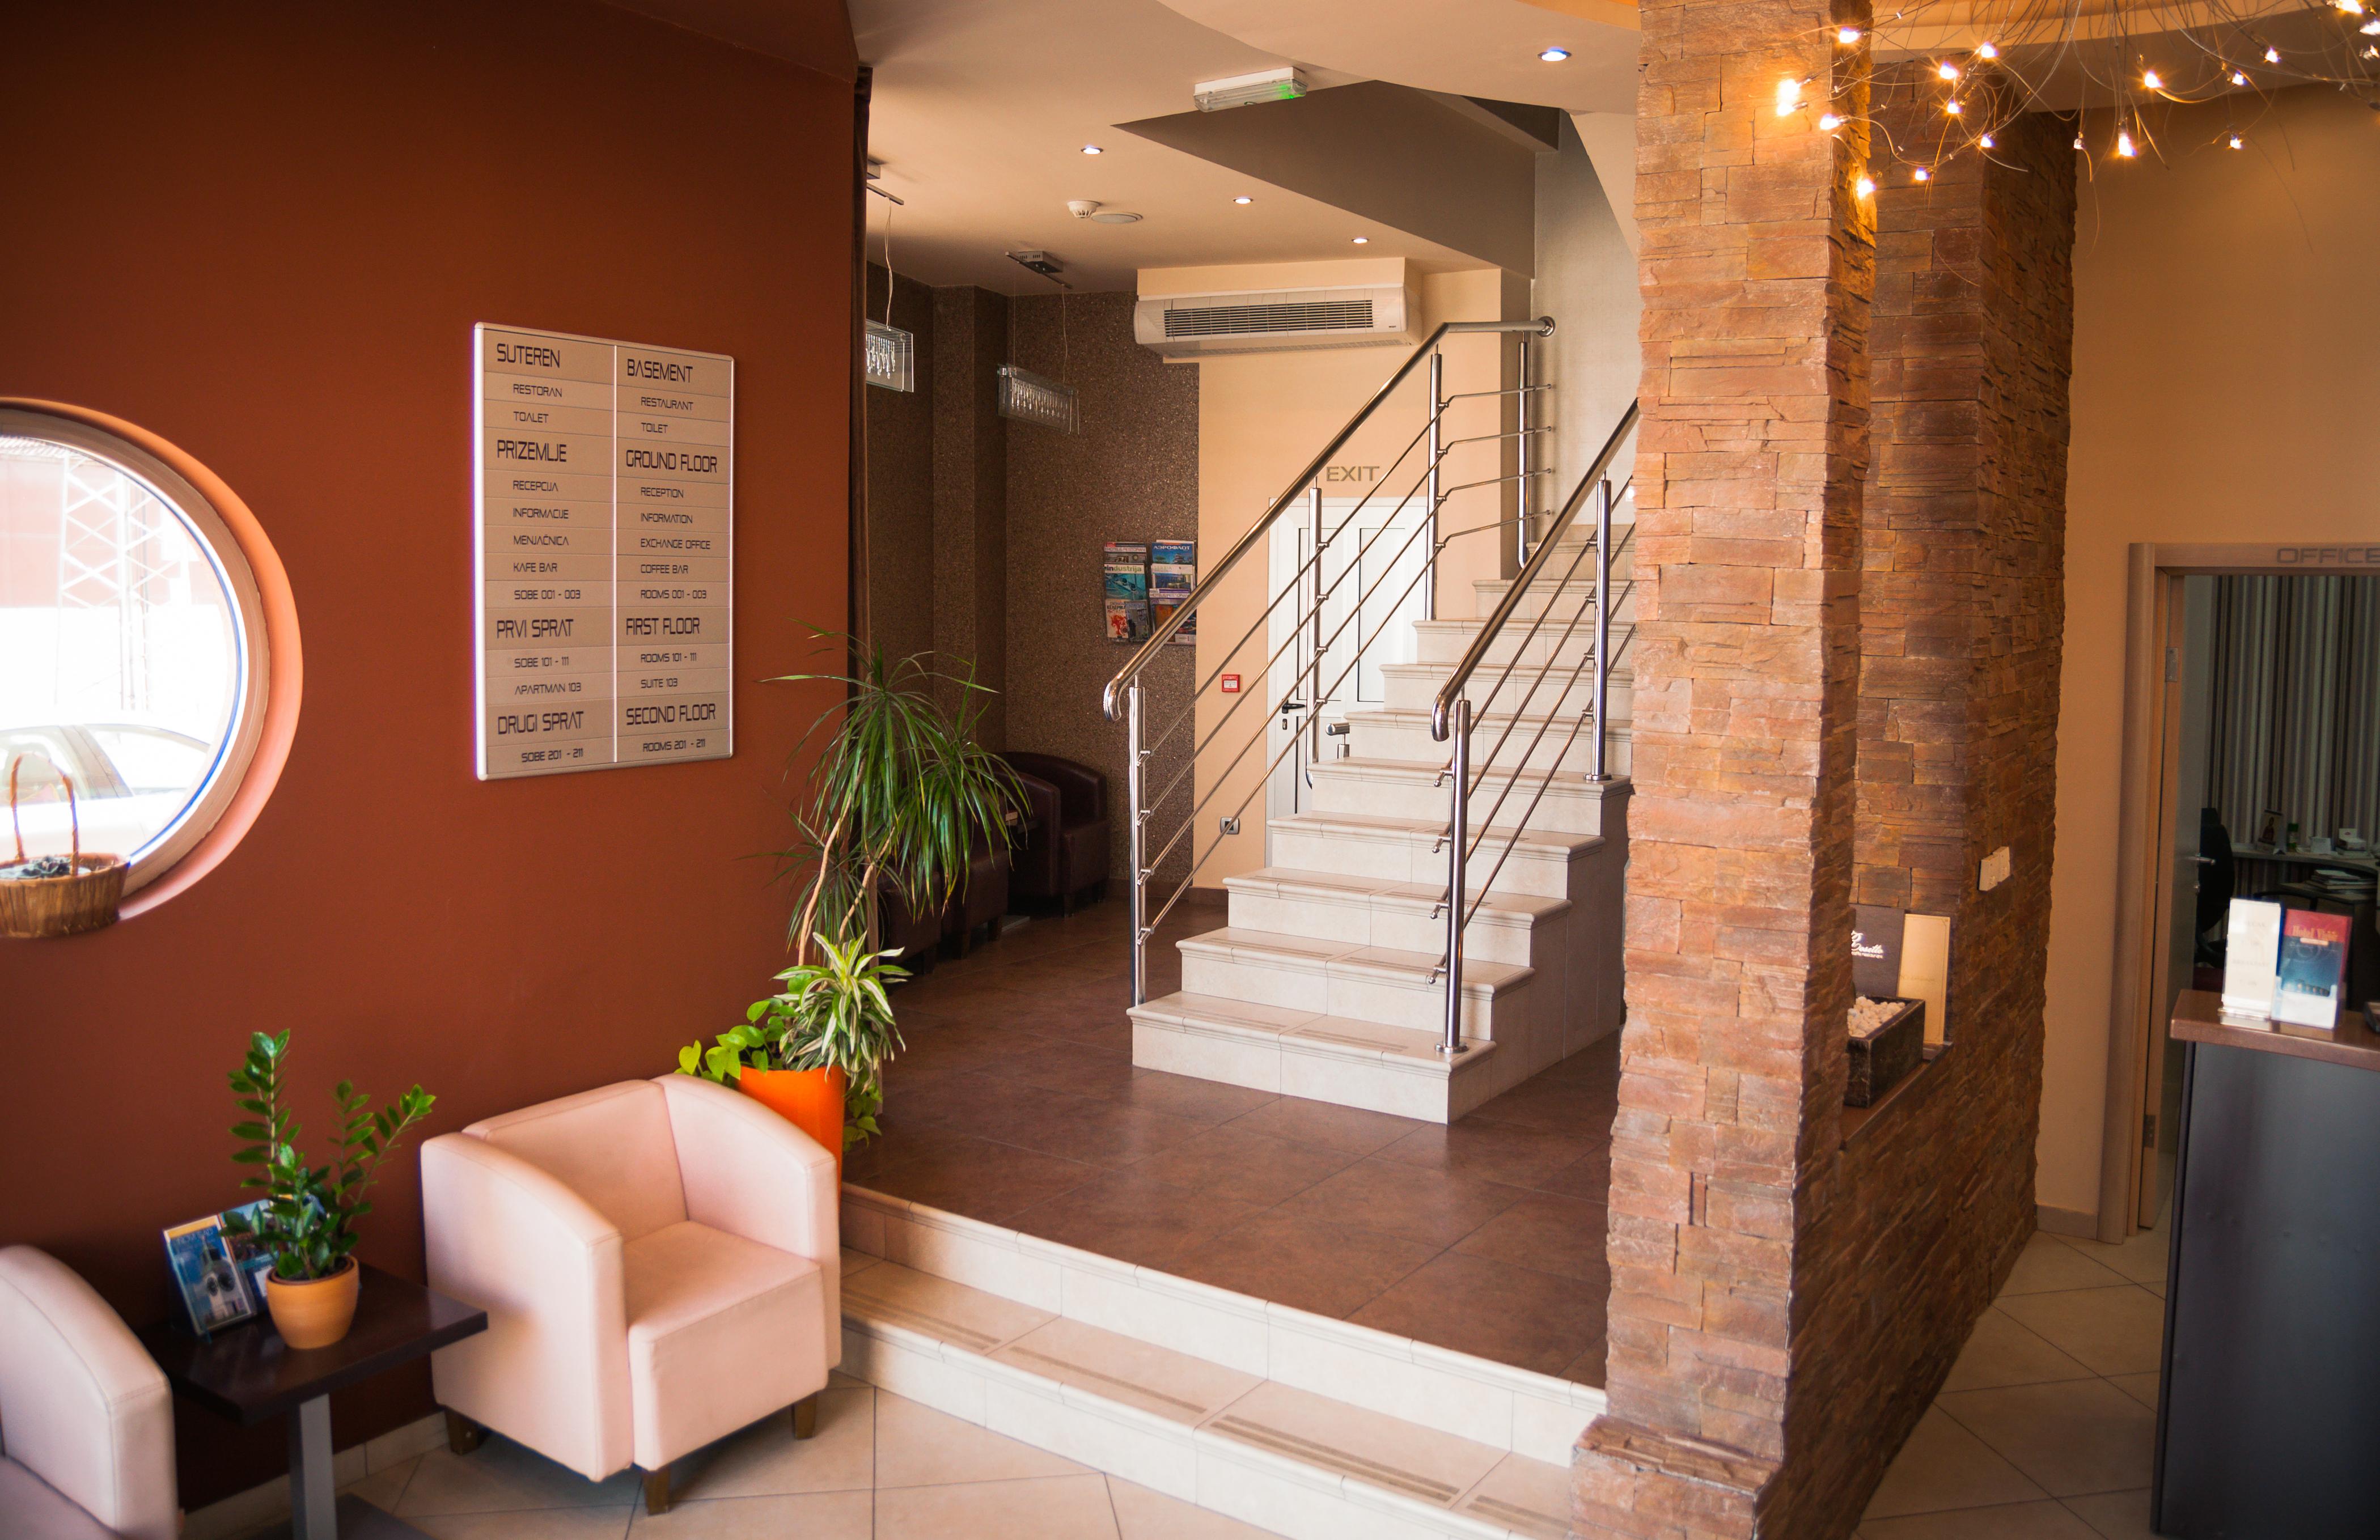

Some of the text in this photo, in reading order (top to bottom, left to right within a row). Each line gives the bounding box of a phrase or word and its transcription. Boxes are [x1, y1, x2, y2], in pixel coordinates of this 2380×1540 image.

[497, 343, 560, 368] SUTEREN
[627, 358, 693, 383] BASEMENT
[513, 383, 562, 397] RESTORAN
[641, 396, 694, 410] RESTAURANT
[513, 411, 549, 423] TOALET
[641, 422, 668, 434] TOILET
[497, 439, 567, 463] PRIZEMLJE
[626, 449, 717, 473] GROUND FLOOR
[1326, 466, 1380, 481] EXIT
[513, 480, 558, 491] RECEPCIJA
[641, 487, 684, 498] RECEPTION
[513, 507, 569, 519] INFORMACIJE
[641, 512, 693, 524] INFORMATION
[513, 534, 569, 546] MENJAČNICA
[640, 538, 711, 550] EXCHANGE OFFICE
[2276, 548, 2380, 563] OFFICE
[513, 562, 558, 572] KAFE BAR
[641, 564, 688, 574] COFFEE BAR
[514, 589, 539, 600] SOBE
[541, 589, 555, 600] 001
[564, 589, 581, 600] 003
[640, 589, 670, 599] ROOMS
[672, 589, 684, 599] 001
[692, 589, 707, 599] 003
[497, 618, 574, 639] PRVI SPRAT
[626, 617, 700, 635] FIRST FLOOR
[514, 657, 539, 668] SOBE
[541, 657, 552, 667] 101
[641, 653, 670, 663] ROOMS
[672, 652, 682, 662] 101
[514, 682, 581, 695] APARTMAN 103
[641, 677, 678, 689] SUITE 103
[626, 703, 716, 726] SECOND FLOOR
[498, 711, 584, 735] DRUGI SPRAT
[643, 741, 672, 752] ROOMS
[674, 740, 687, 750] 201
[696, 739, 705, 748] 211
[521, 750, 545, 763] SOBE
[548, 749, 562, 761] 201
[573, 748, 583, 758] 211
